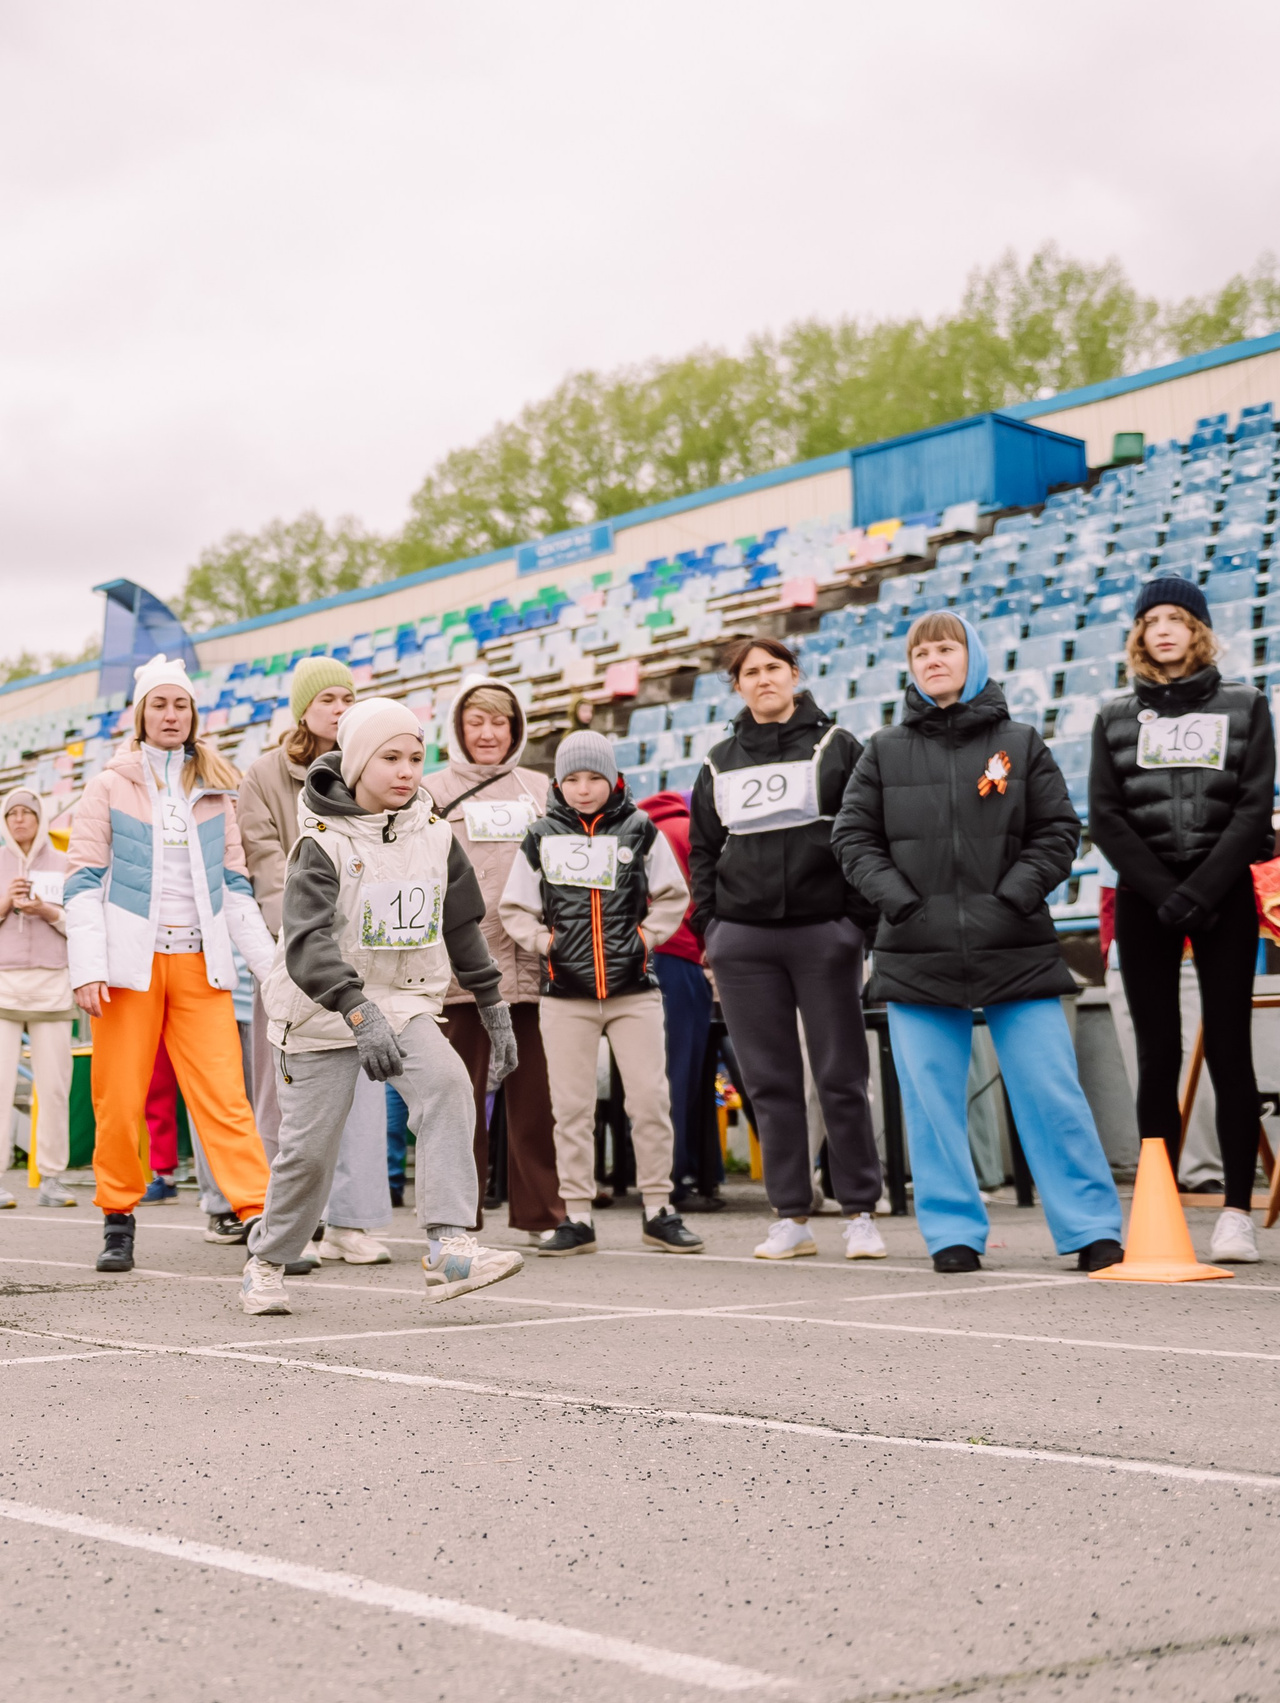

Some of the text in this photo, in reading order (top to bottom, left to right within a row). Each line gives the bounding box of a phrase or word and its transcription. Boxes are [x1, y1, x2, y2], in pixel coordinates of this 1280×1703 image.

[1167, 719, 1203, 751] 16
[741, 773, 788, 810] 29
[490, 803, 511, 827] 5
[565, 842, 590, 871] 3
[389, 886, 425, 930] 12
